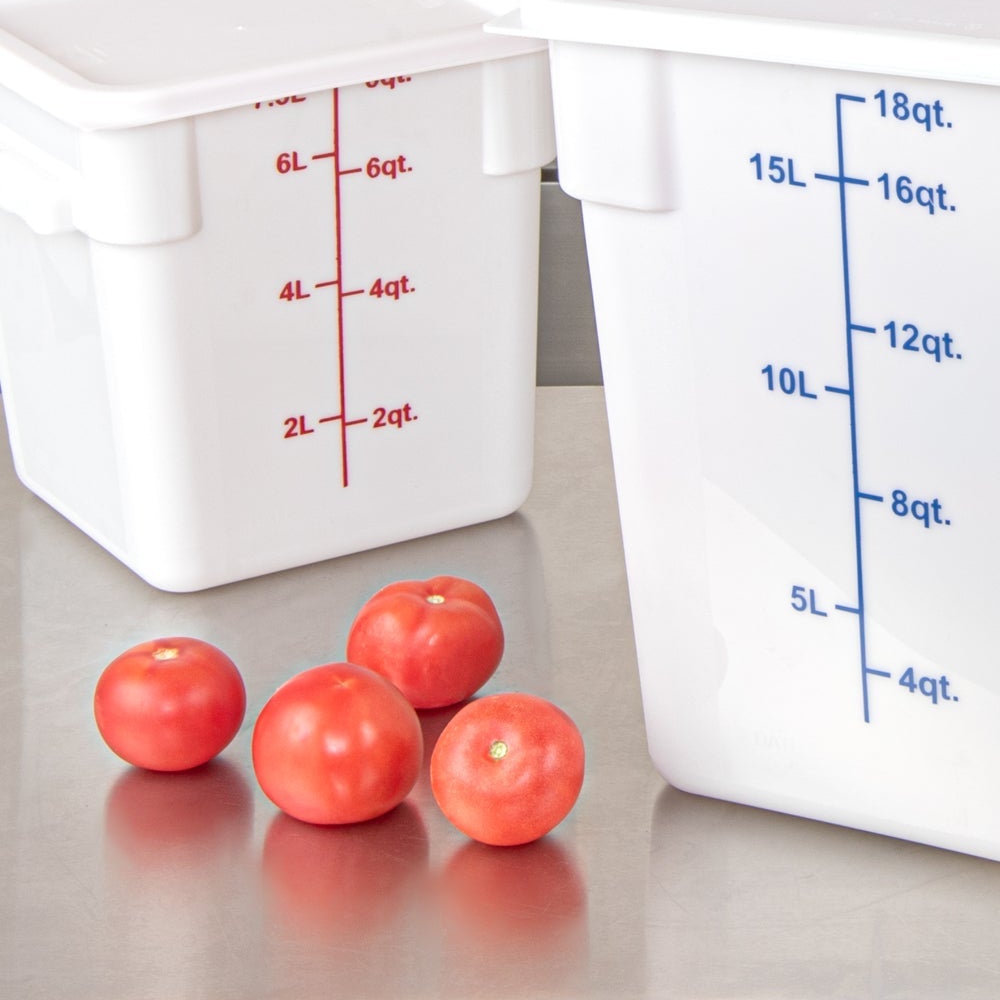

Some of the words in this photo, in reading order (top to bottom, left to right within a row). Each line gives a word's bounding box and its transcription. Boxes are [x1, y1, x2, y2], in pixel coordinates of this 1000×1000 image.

[873, 89, 953, 132] 18qt.
[276, 151, 308, 174] 6L
[366, 155, 413, 179] 6qt.
[749, 152, 807, 188] 15L
[877, 172, 957, 215] 16qt.
[279, 280, 311, 301] 4L
[369, 275, 416, 300] 4qt.
[883, 320, 963, 363] 12qt.
[761, 364, 818, 400] 10L
[284, 415, 314, 438] 2L
[372, 403, 418, 429] 2qt.
[891, 489, 952, 529] 8qt.
[790, 585, 828, 617] 5L
[898, 667, 960, 705] 4qt.
